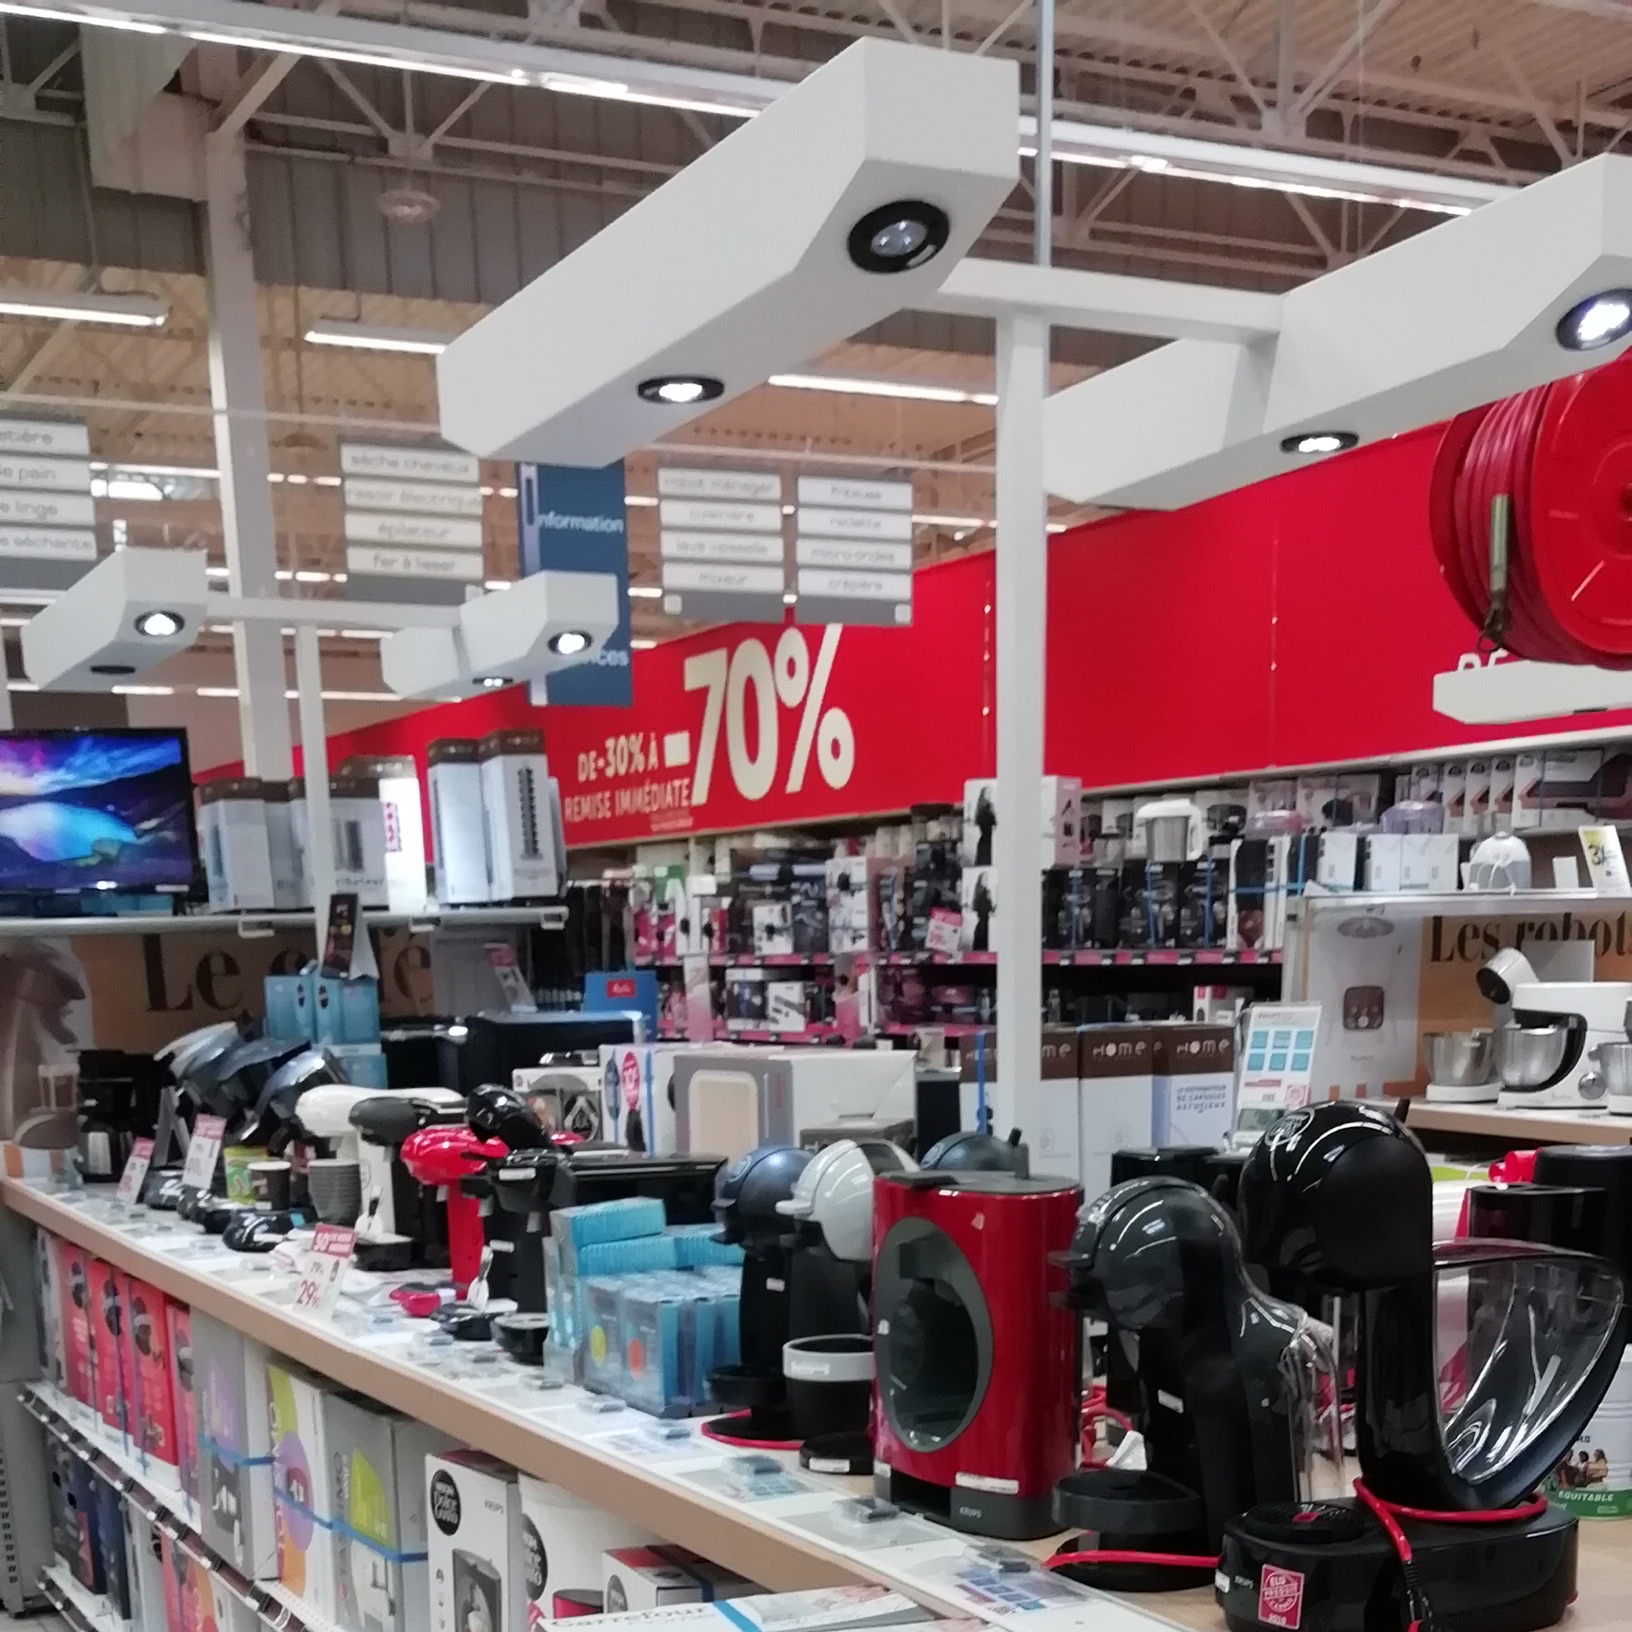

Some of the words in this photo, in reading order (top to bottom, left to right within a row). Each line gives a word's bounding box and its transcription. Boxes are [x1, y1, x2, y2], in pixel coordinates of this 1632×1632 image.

[537, 511, 625, 534] nformation
[565, 790, 612, 824] REMISE
[615, 777, 691, 817] IMMÉDIATE
[1431, 914, 1500, 964] Les
[1516, 911, 1632, 958] robot
[143, 933, 242, 1013] Le
